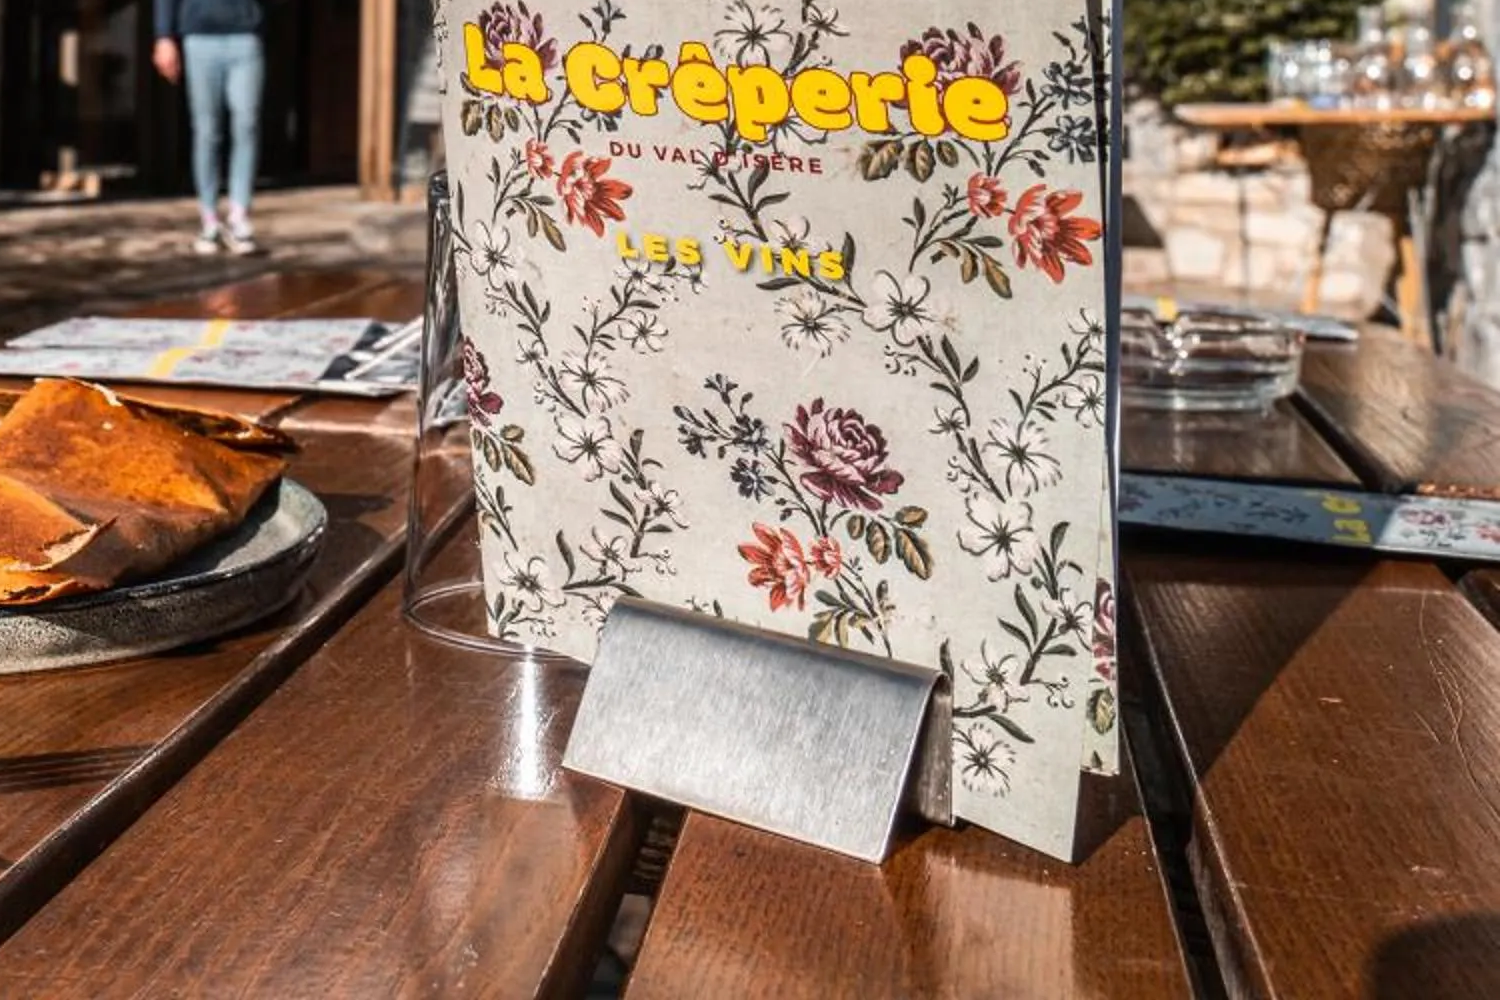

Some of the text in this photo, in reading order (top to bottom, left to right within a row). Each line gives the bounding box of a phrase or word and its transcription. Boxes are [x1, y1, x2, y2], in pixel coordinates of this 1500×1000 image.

[461, 21, 1010, 142] La Crêperie
[608, 140, 643, 159] DU
[653, 144, 702, 165] VAL
[615, 231, 846, 282] LES VINS
